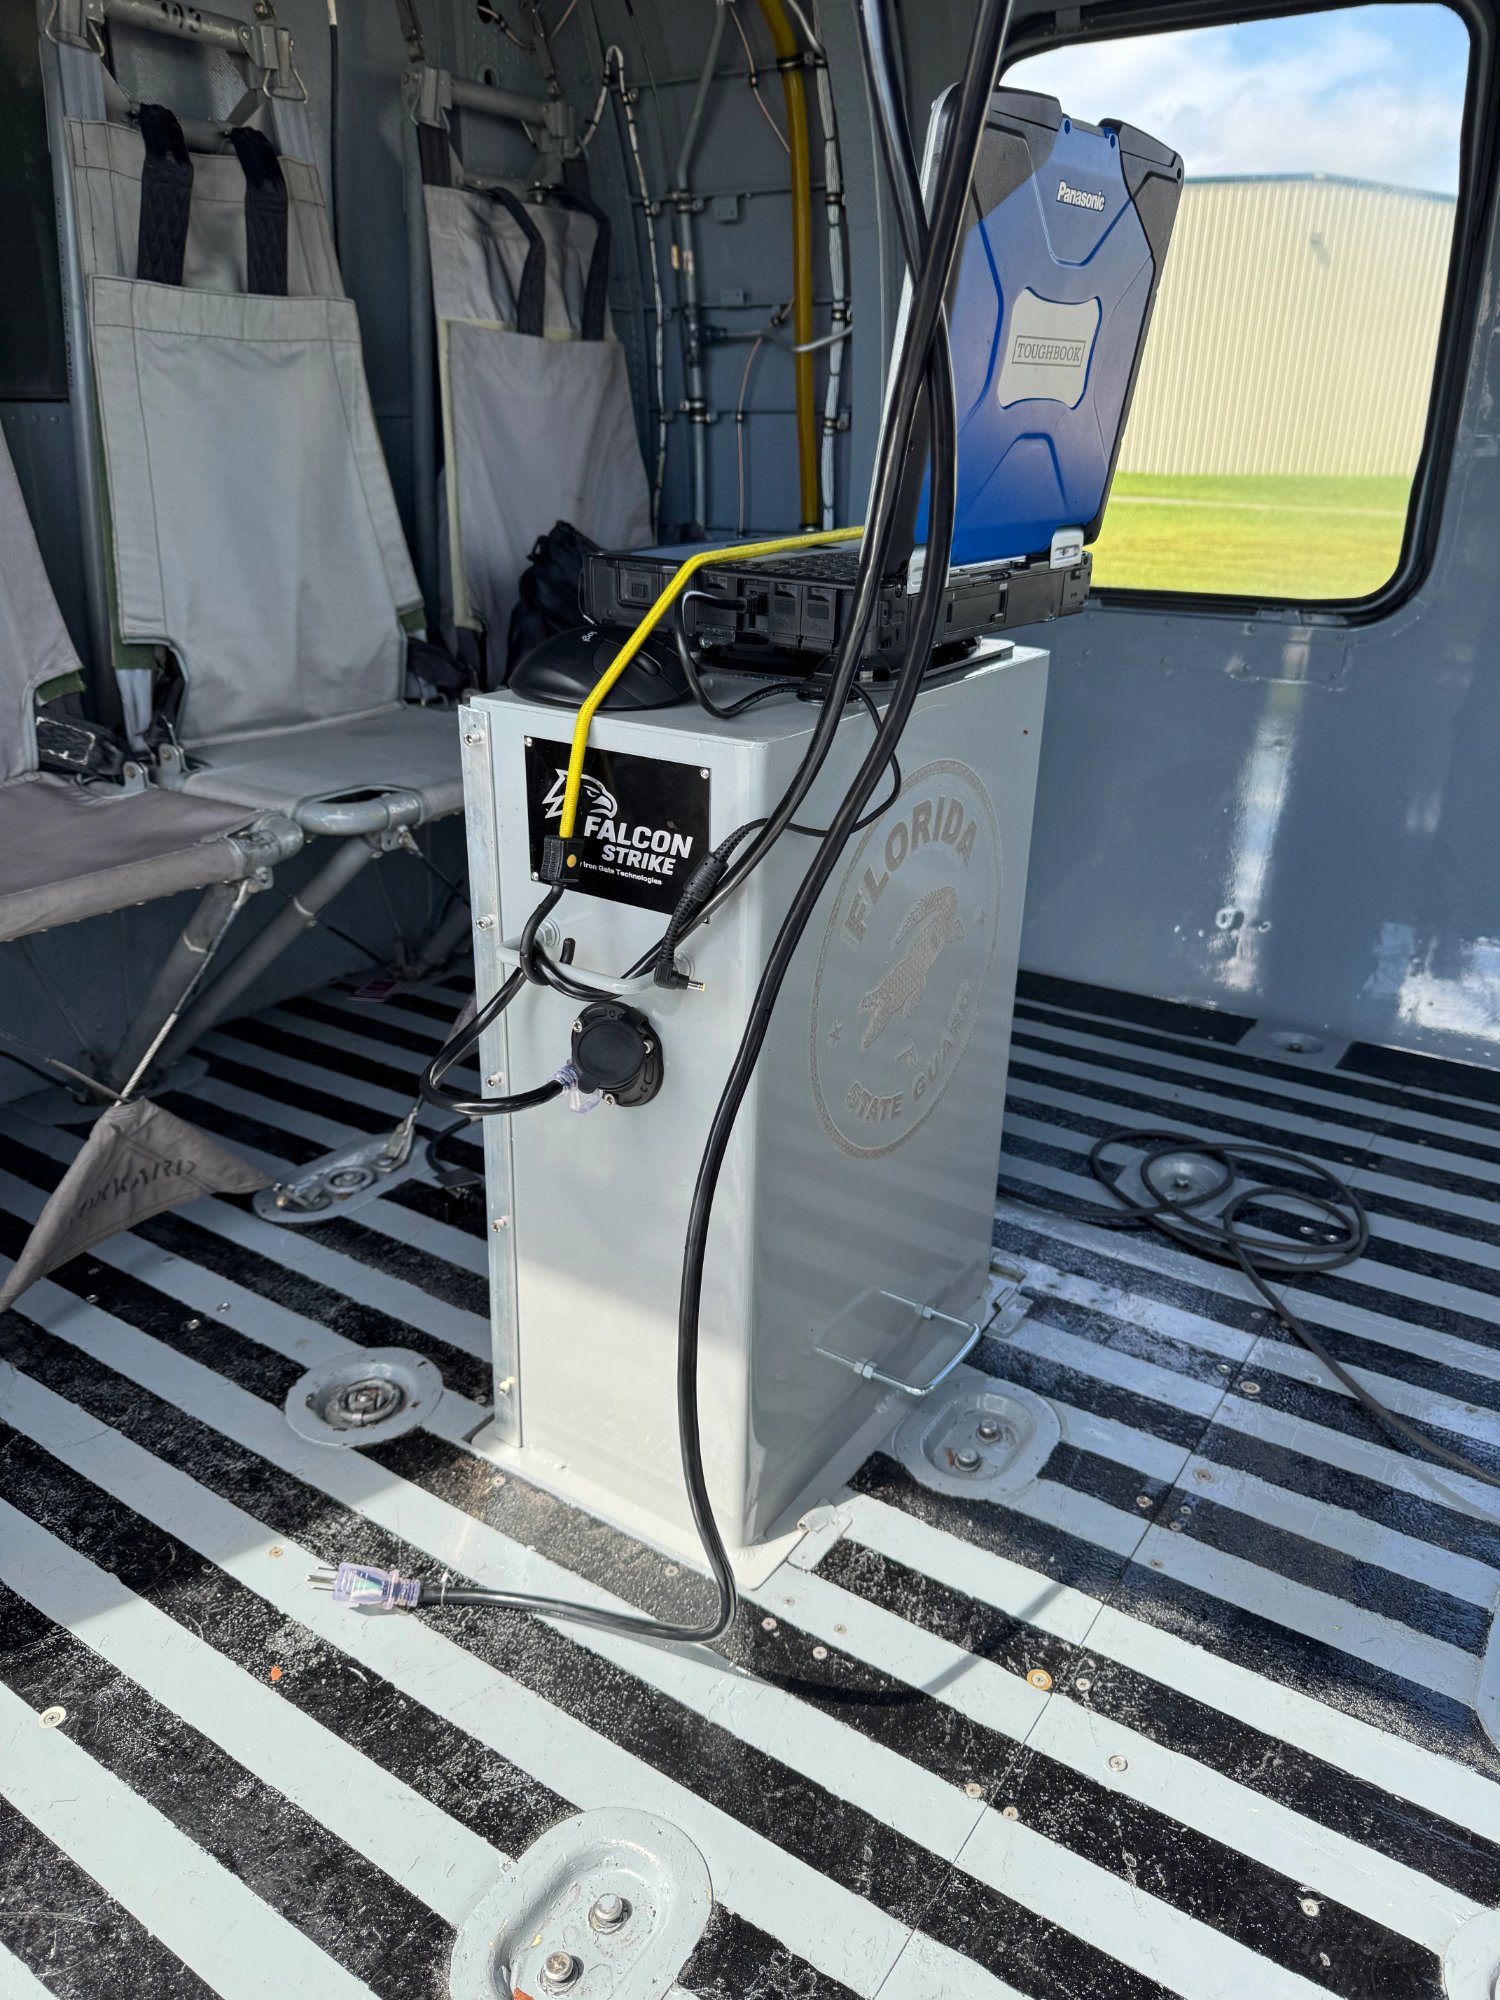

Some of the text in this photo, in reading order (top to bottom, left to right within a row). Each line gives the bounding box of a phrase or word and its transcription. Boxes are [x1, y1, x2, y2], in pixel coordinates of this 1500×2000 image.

[1056, 180, 1105, 211] Panasonic
[1017, 343, 1082, 362] TOUGHBOOK
[584, 815, 694, 859] FALCON
[583, 861, 597, 870] Iron
[598, 865, 615, 874] Gate
[616, 868, 662, 885] Technologies
[602, 844, 676, 876] STRIKE
[844, 796, 977, 942] FLORIDA
[845, 1081, 903, 1122] STATE
